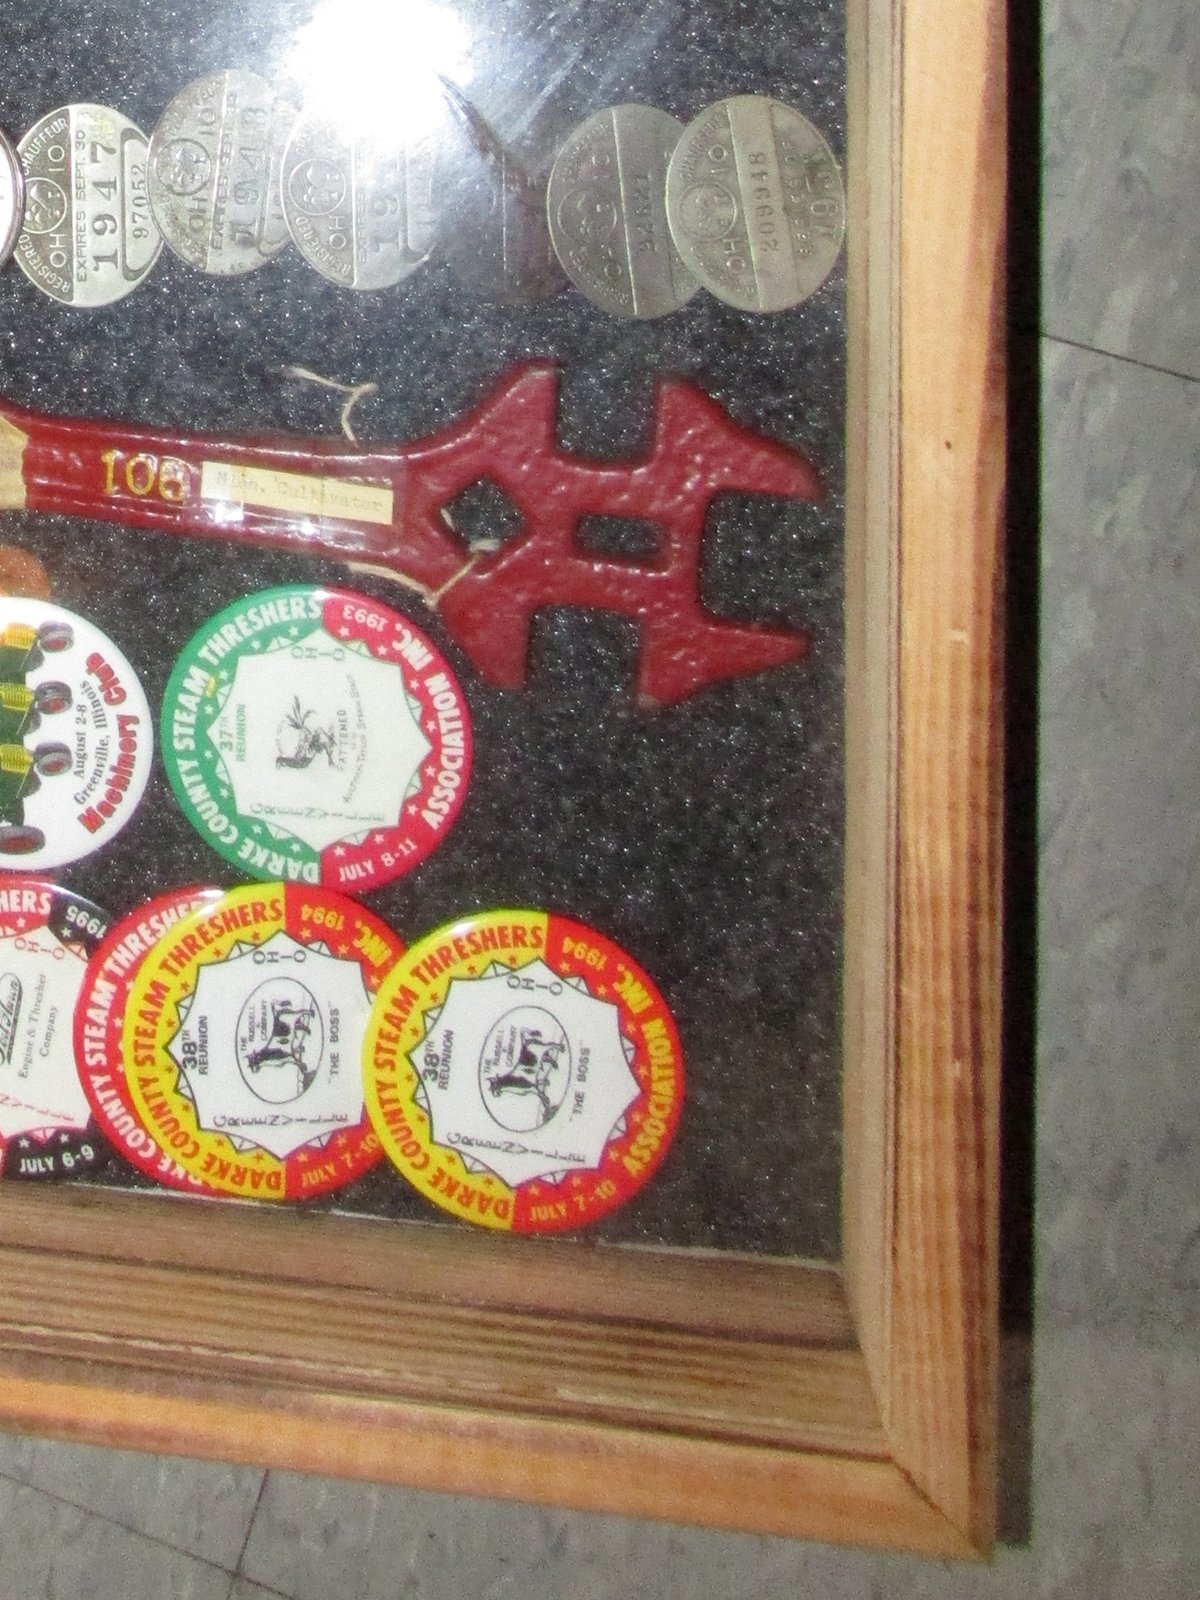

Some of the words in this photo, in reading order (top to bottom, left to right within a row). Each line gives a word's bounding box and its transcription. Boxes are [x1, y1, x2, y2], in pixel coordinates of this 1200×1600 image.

[21, 116, 69, 176] CHAUFFEUR
[75, 129, 86, 148] 30
[90, 140, 119, 272] 1947
[131, 162, 149, 239] 97052
[19, 233, 72, 293] REGISTERED
[75, 210, 87, 282] EXPIRES
[197, 596, 322, 665] THRESHERS
[343, 604, 387, 631] 1993
[292, 646, 345, 660] OHIO
[392, 623, 433, 671] INC.
[79, 679, 108, 729] Illinois
[84, 651, 127, 706] Club
[75, 703, 87, 725] 2-8
[173, 664, 210, 751] STEAM
[235, 704, 246, 762] REUNION
[73, 731, 88, 779] August
[337, 709, 348, 771] FATTENED
[421, 672, 465, 830] ASSOCIATION
[77, 713, 140, 835] Machinery
[176, 757, 237, 844] COUNTY
[238, 837, 320, 884] DARKE
[339, 860, 375, 880] JULY
[380, 837, 418, 867] 8-11
[65, 904, 109, 939] 1995
[160, 898, 284, 976] THRESHERS
[300, 904, 344, 931] 1994
[351, 919, 393, 967] INC.
[14, 937, 65, 960] OHIO
[253, 950, 307, 964] OHIO
[410, 925, 544, 986] THRESHERS
[561, 936, 608, 970] 1994
[506, 975, 563, 996] OHIO
[612, 963, 652, 1013] INC.
[16, 1041, 36, 1079] Engine
[27, 972, 47, 1023] Thresher
[39, 1004, 60, 1058] Company
[84, 977, 117, 1065] STEAM
[134, 978, 171, 1067] STEAM
[198, 1016, 209, 1075] REUNION
[260, 1000, 268, 1041] COMPANY
[373, 983, 419, 1071] STEAM
[505, 1025, 517, 1067] COMPANY
[437, 1029, 454, 1090] REUNION
[88, 1074, 156, 1158] COUNTY
[139, 1075, 195, 1159] COUNTY
[623, 1017, 676, 1176] ASSOCIATION
[375, 1077, 432, 1171] COUNTY
[447, 1133, 586, 1163] GREENVILLE
[18, 1155, 56, 1174] JULY
[61, 1143, 96, 1168] 6-9
[201, 1153, 282, 1190] DARKE
[300, 1162, 338, 1184] JULY
[431, 1170, 509, 1219] DARKE
[530, 1201, 567, 1220] JULY
[575, 1178, 617, 1210] 7-10
